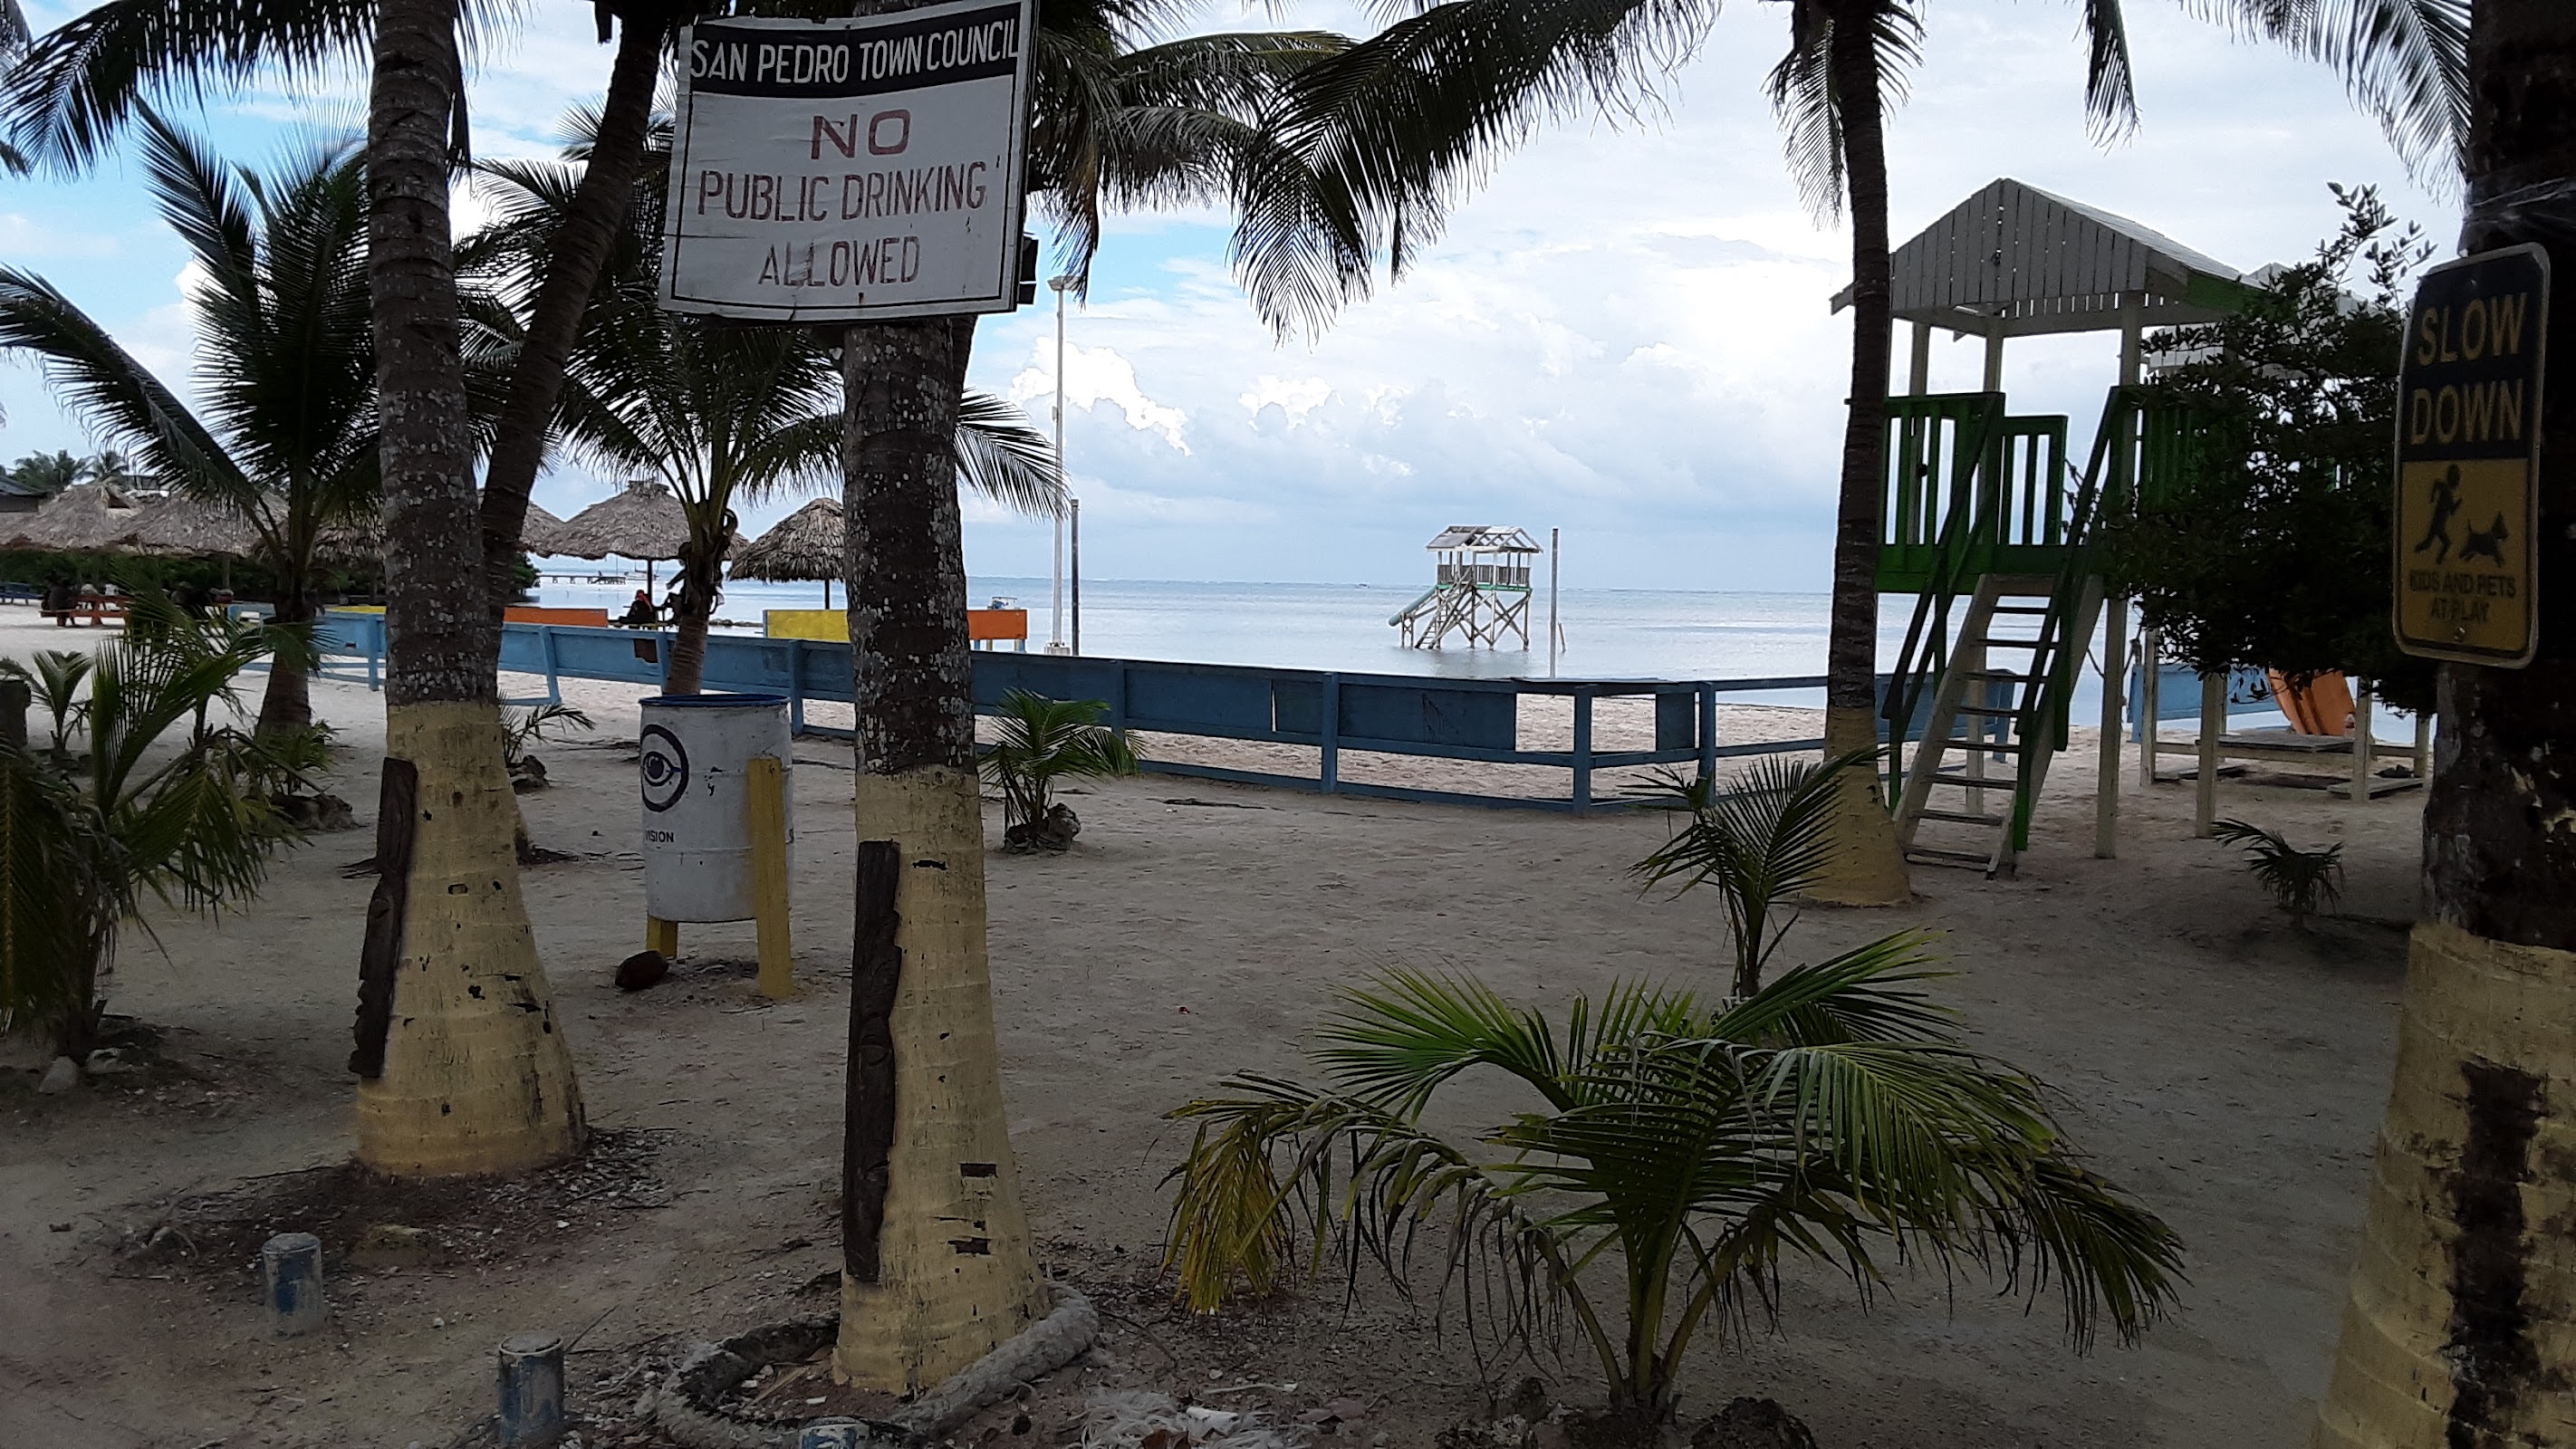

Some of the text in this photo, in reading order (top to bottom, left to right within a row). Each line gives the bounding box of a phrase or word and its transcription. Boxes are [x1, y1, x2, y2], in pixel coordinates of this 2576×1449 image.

[690, 19, 1019, 84] SAN PEDRO TOWN COUNCIL
[811, 109, 911, 159] NO
[697, 161, 986, 221] PUBLIC DRINKING
[757, 235, 920, 287] ALLOWED
[2417, 293, 2526, 366] SLOW
[2411, 379, 2523, 444] DOWN
[2410, 570, 2516, 598] KIDS AND PETS
[2431, 597, 2490, 623] AT PLAY
